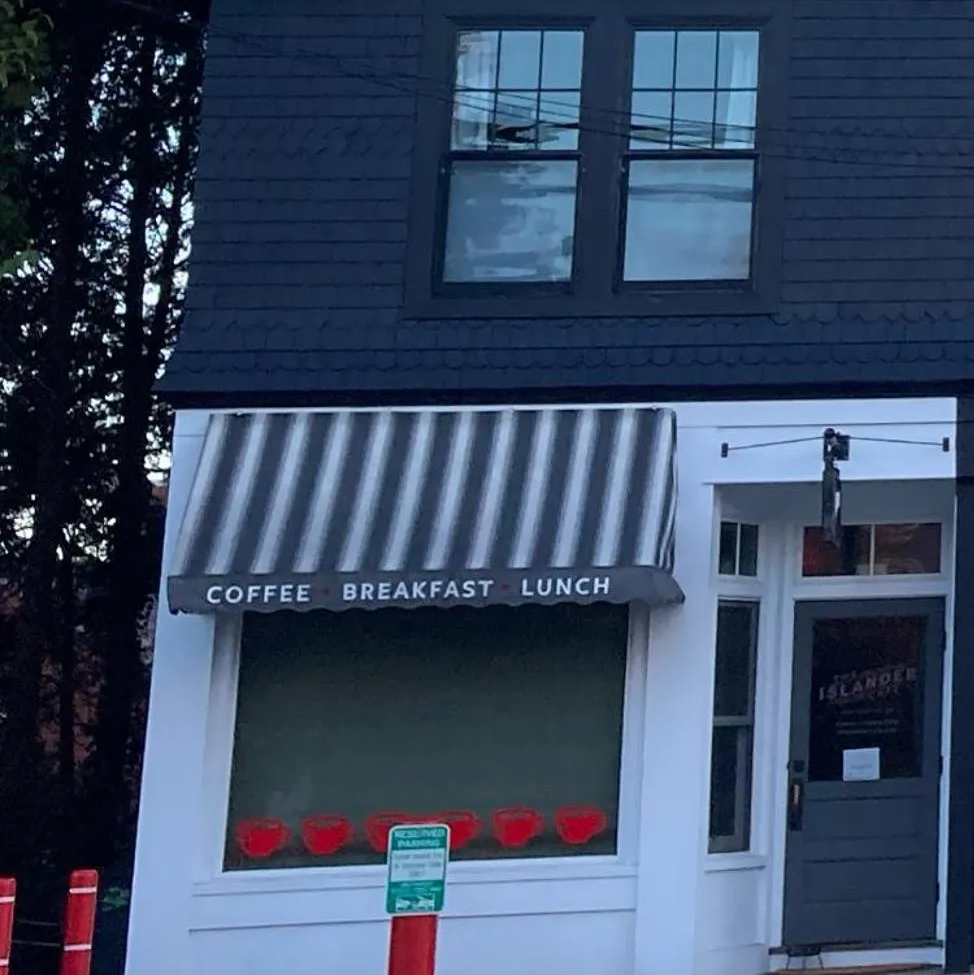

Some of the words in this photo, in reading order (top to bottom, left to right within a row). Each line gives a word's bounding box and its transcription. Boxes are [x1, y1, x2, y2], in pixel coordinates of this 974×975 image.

[206, 584, 311, 605] COFFEE
[342, 579, 494, 601] BREAKFAST
[521, 576, 610, 597] LUNCH
